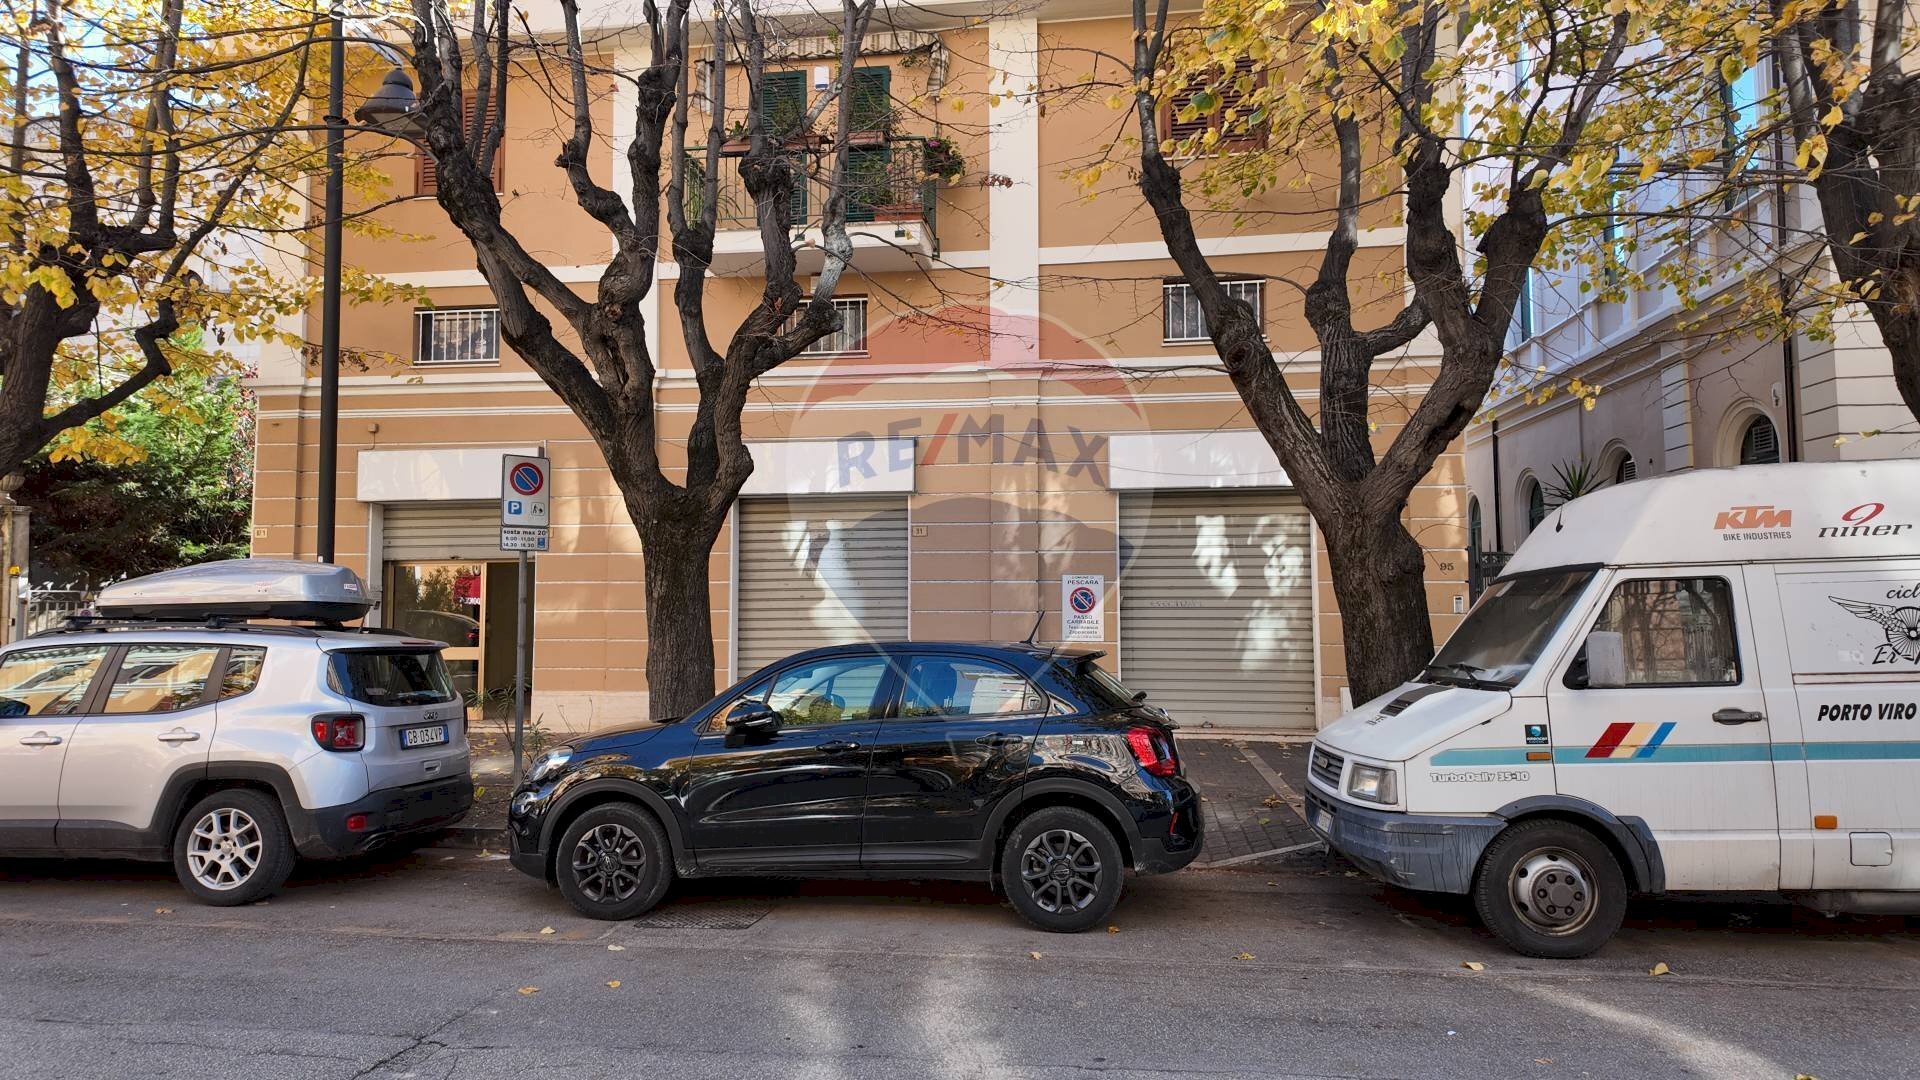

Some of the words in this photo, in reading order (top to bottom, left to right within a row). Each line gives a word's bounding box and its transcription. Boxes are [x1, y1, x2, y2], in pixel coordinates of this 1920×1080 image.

[1713, 505, 1792, 530] KTM
[1723, 533, 1742, 541] BIKE
[1743, 531, 1792, 541] INDUSTRIES
[1818, 523, 1913, 538] niner
[1439, 562, 1454, 571] 95
[1817, 703, 1872, 722] PORTO
[1877, 703, 1918, 721] VIRO
[1430, 771, 1496, 783] TurboDaily
